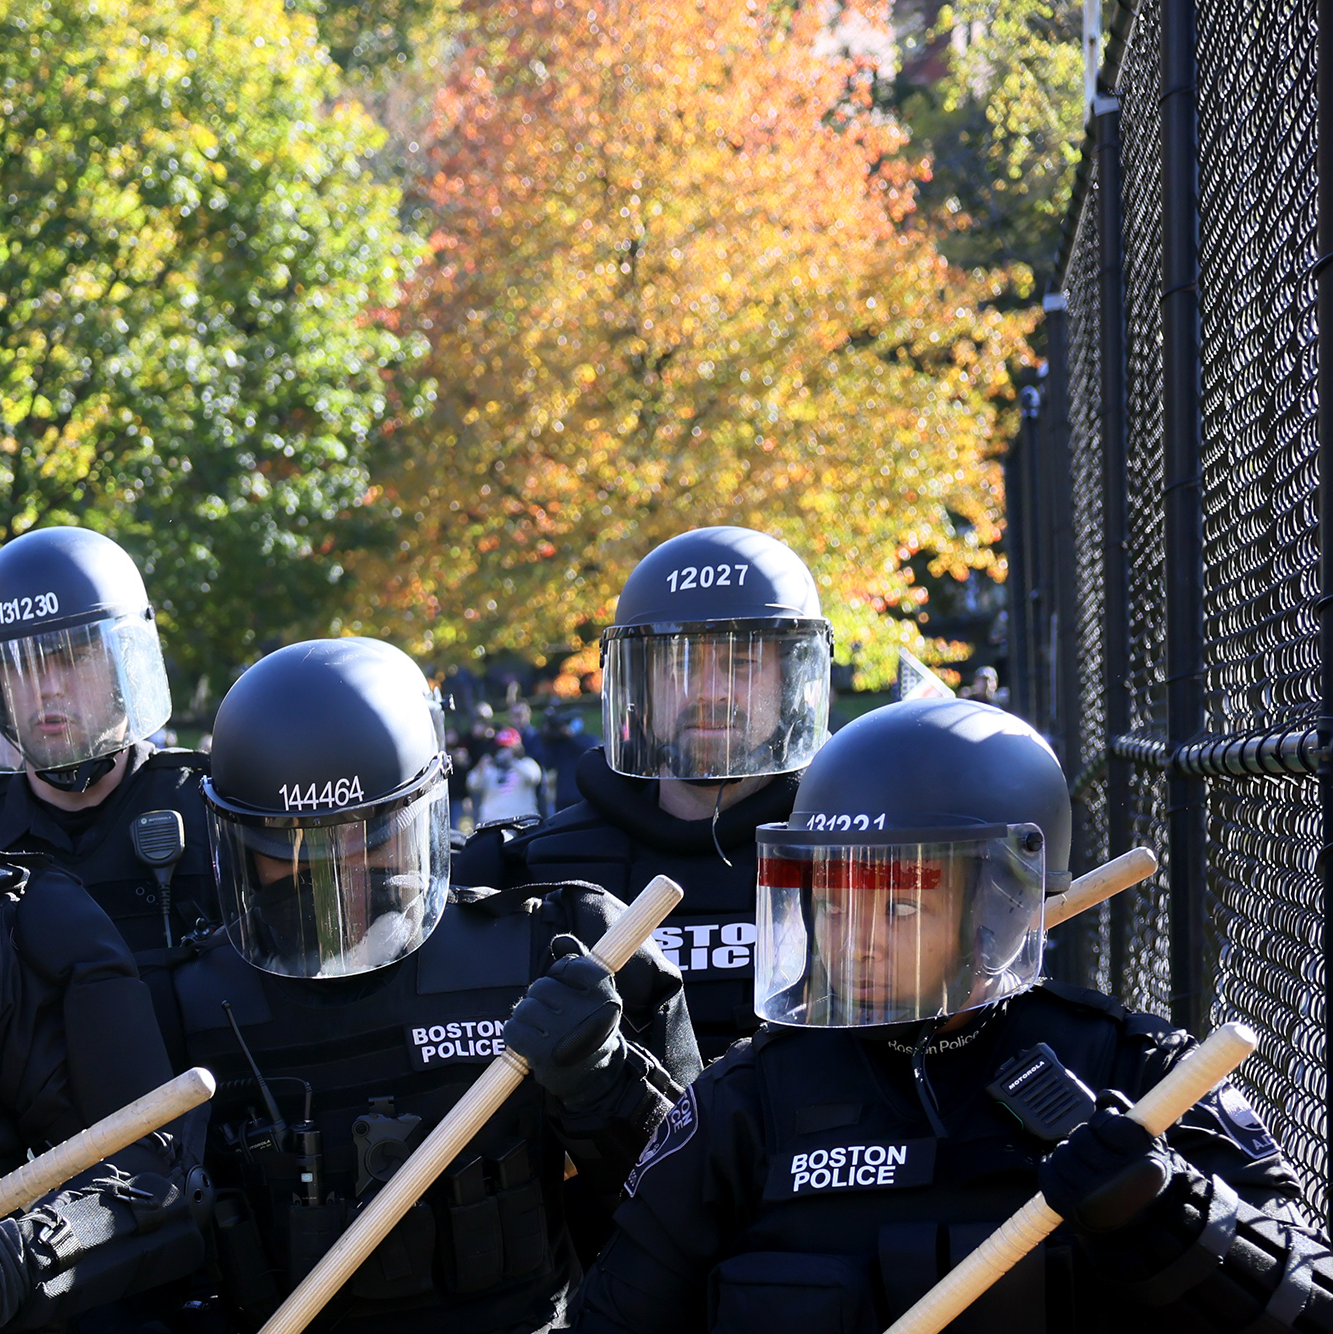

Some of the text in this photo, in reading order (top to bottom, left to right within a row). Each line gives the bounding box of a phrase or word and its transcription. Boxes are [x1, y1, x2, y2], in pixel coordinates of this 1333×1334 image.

[666, 563, 750, 593] 12027
[278, 775, 365, 812] 144464
[654, 921, 757, 951] STO
[663, 945, 751, 971] LIC
[411, 1020, 506, 1047] BOSTON
[421, 1038, 506, 1064] POLICE
[1008, 1060, 1046, 1091] MOTOROLA
[790, 1144, 908, 1175] BOSTON
[792, 1164, 897, 1193] POLICE
